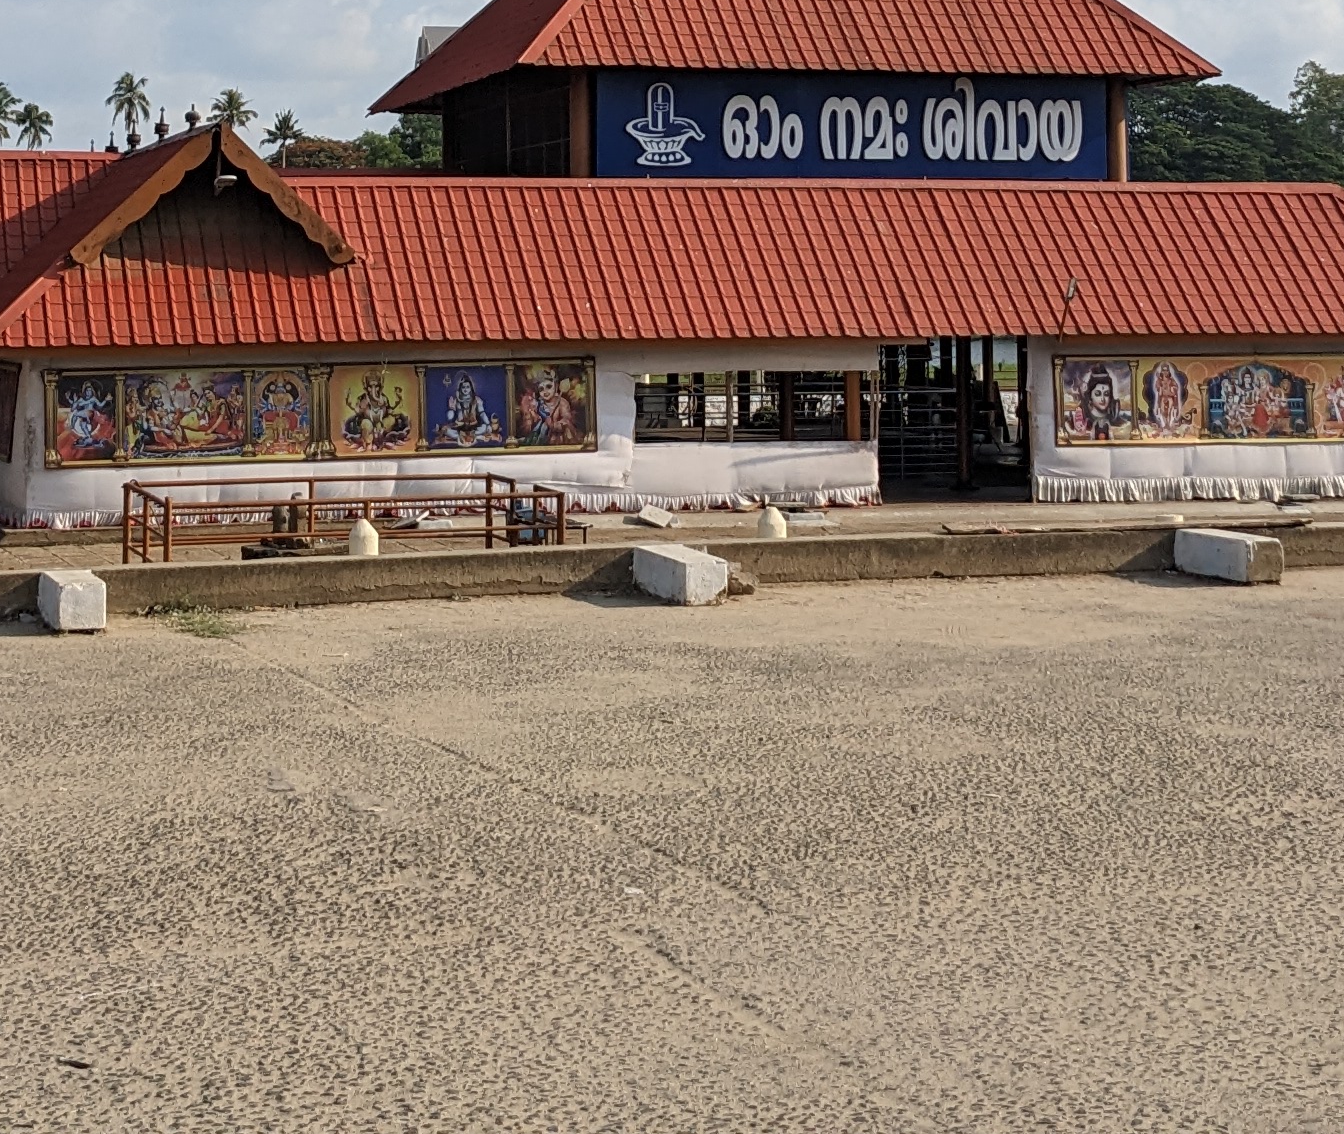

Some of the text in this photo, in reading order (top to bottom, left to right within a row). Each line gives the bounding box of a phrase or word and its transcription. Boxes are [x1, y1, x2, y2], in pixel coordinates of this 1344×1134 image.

[721, 76, 1083, 161] ഓം നമഃ ശിവായ
